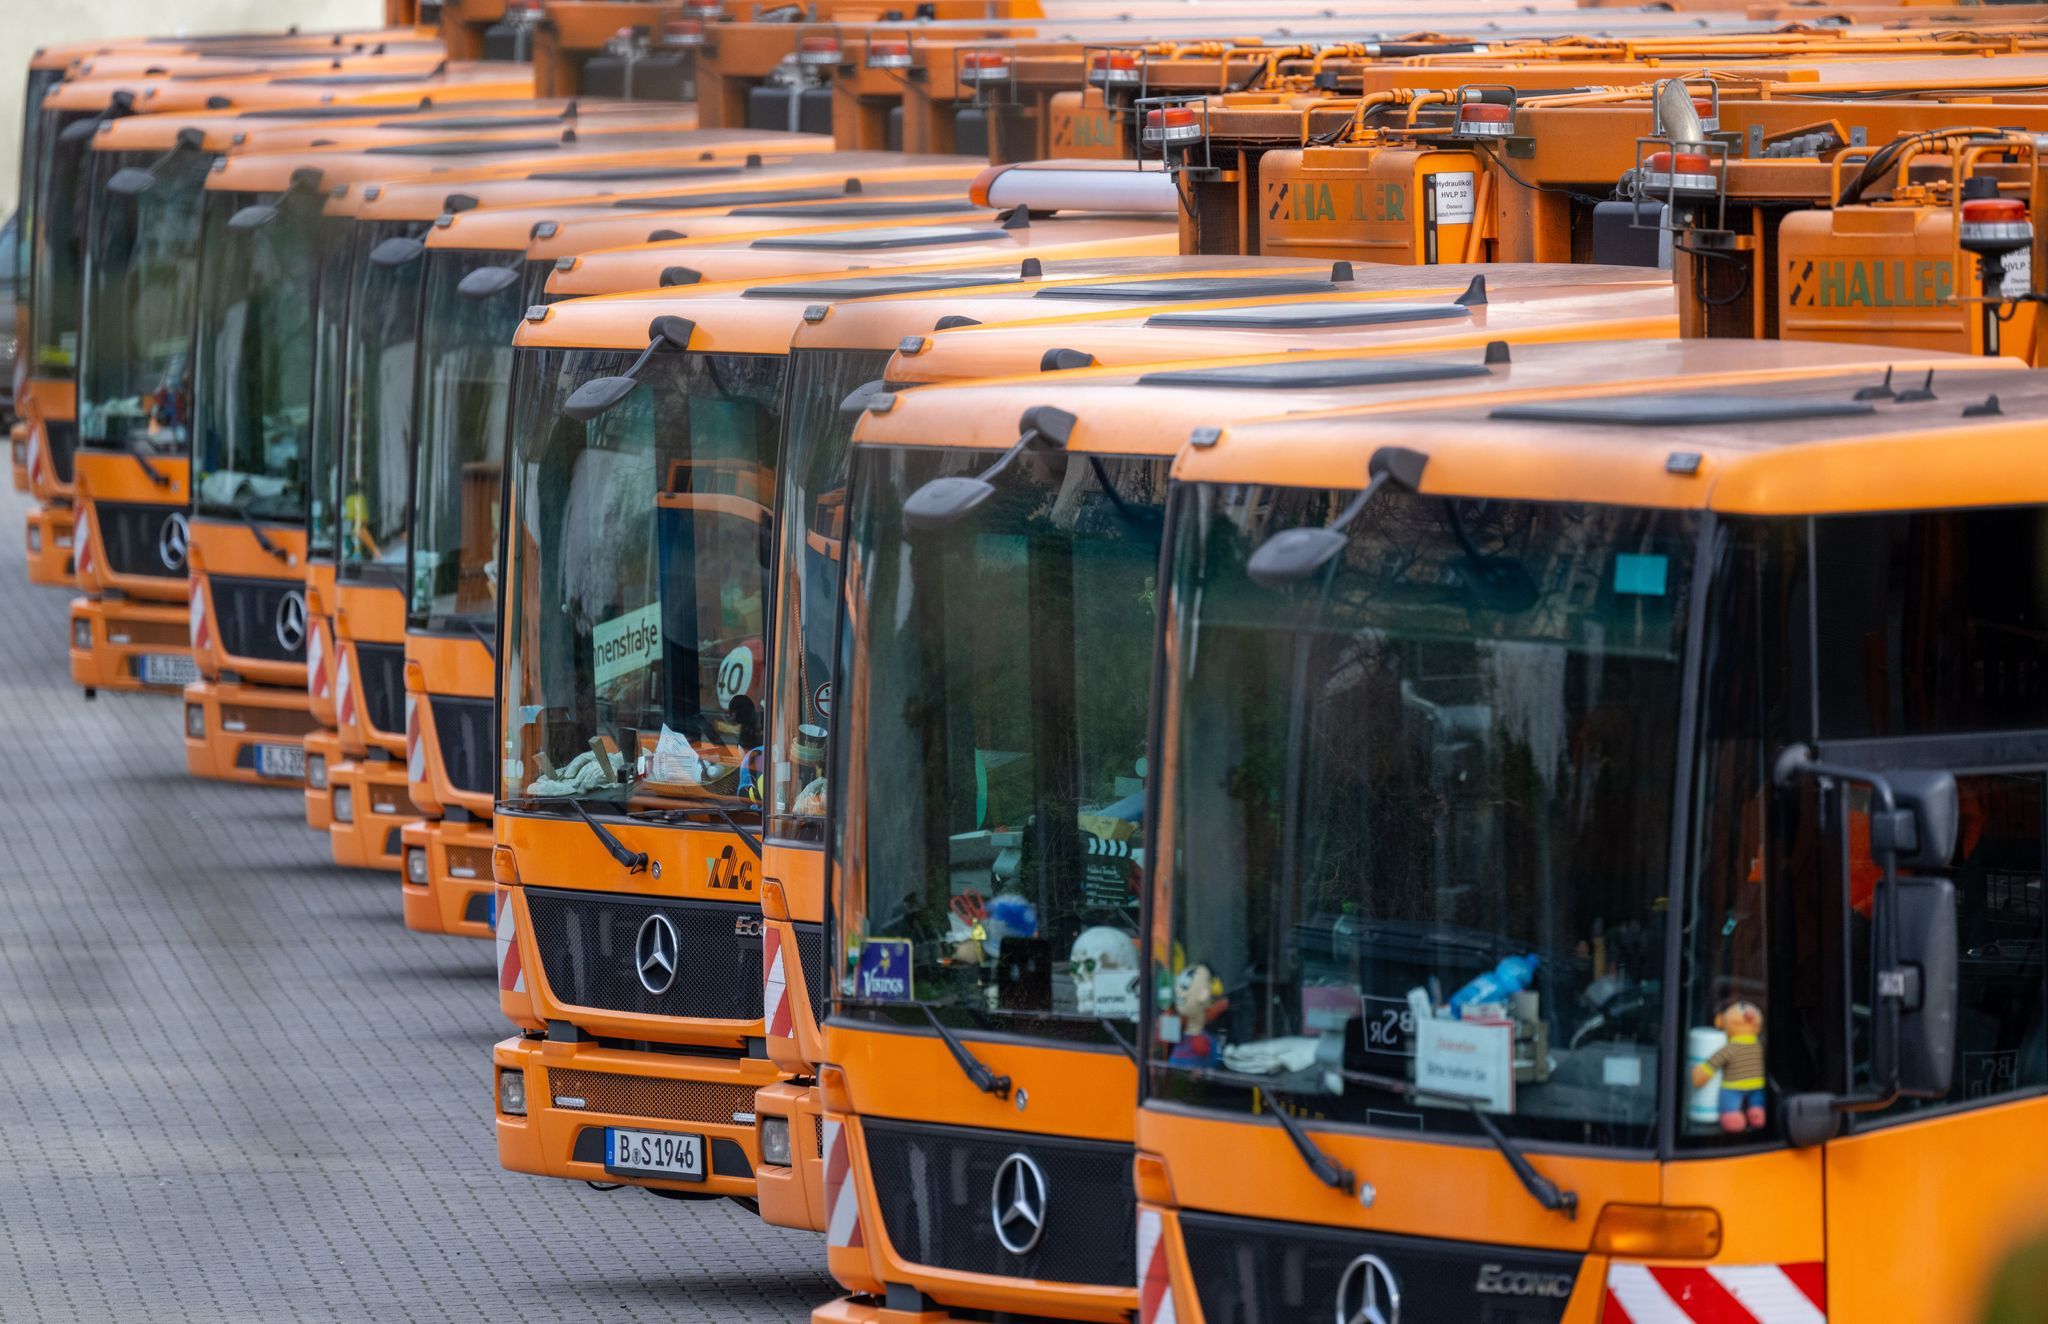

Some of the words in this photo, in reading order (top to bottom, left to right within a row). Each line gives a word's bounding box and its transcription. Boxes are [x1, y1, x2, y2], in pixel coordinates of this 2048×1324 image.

[1436, 179, 1472, 188] Hydrauliköl
[1460, 190, 1467, 198] 32
[1293, 182, 1406, 222] HALER
[1818, 260, 1960, 308] HALLER
[717, 662, 744, 695] 40
[619, 1134, 631, 1163] B
